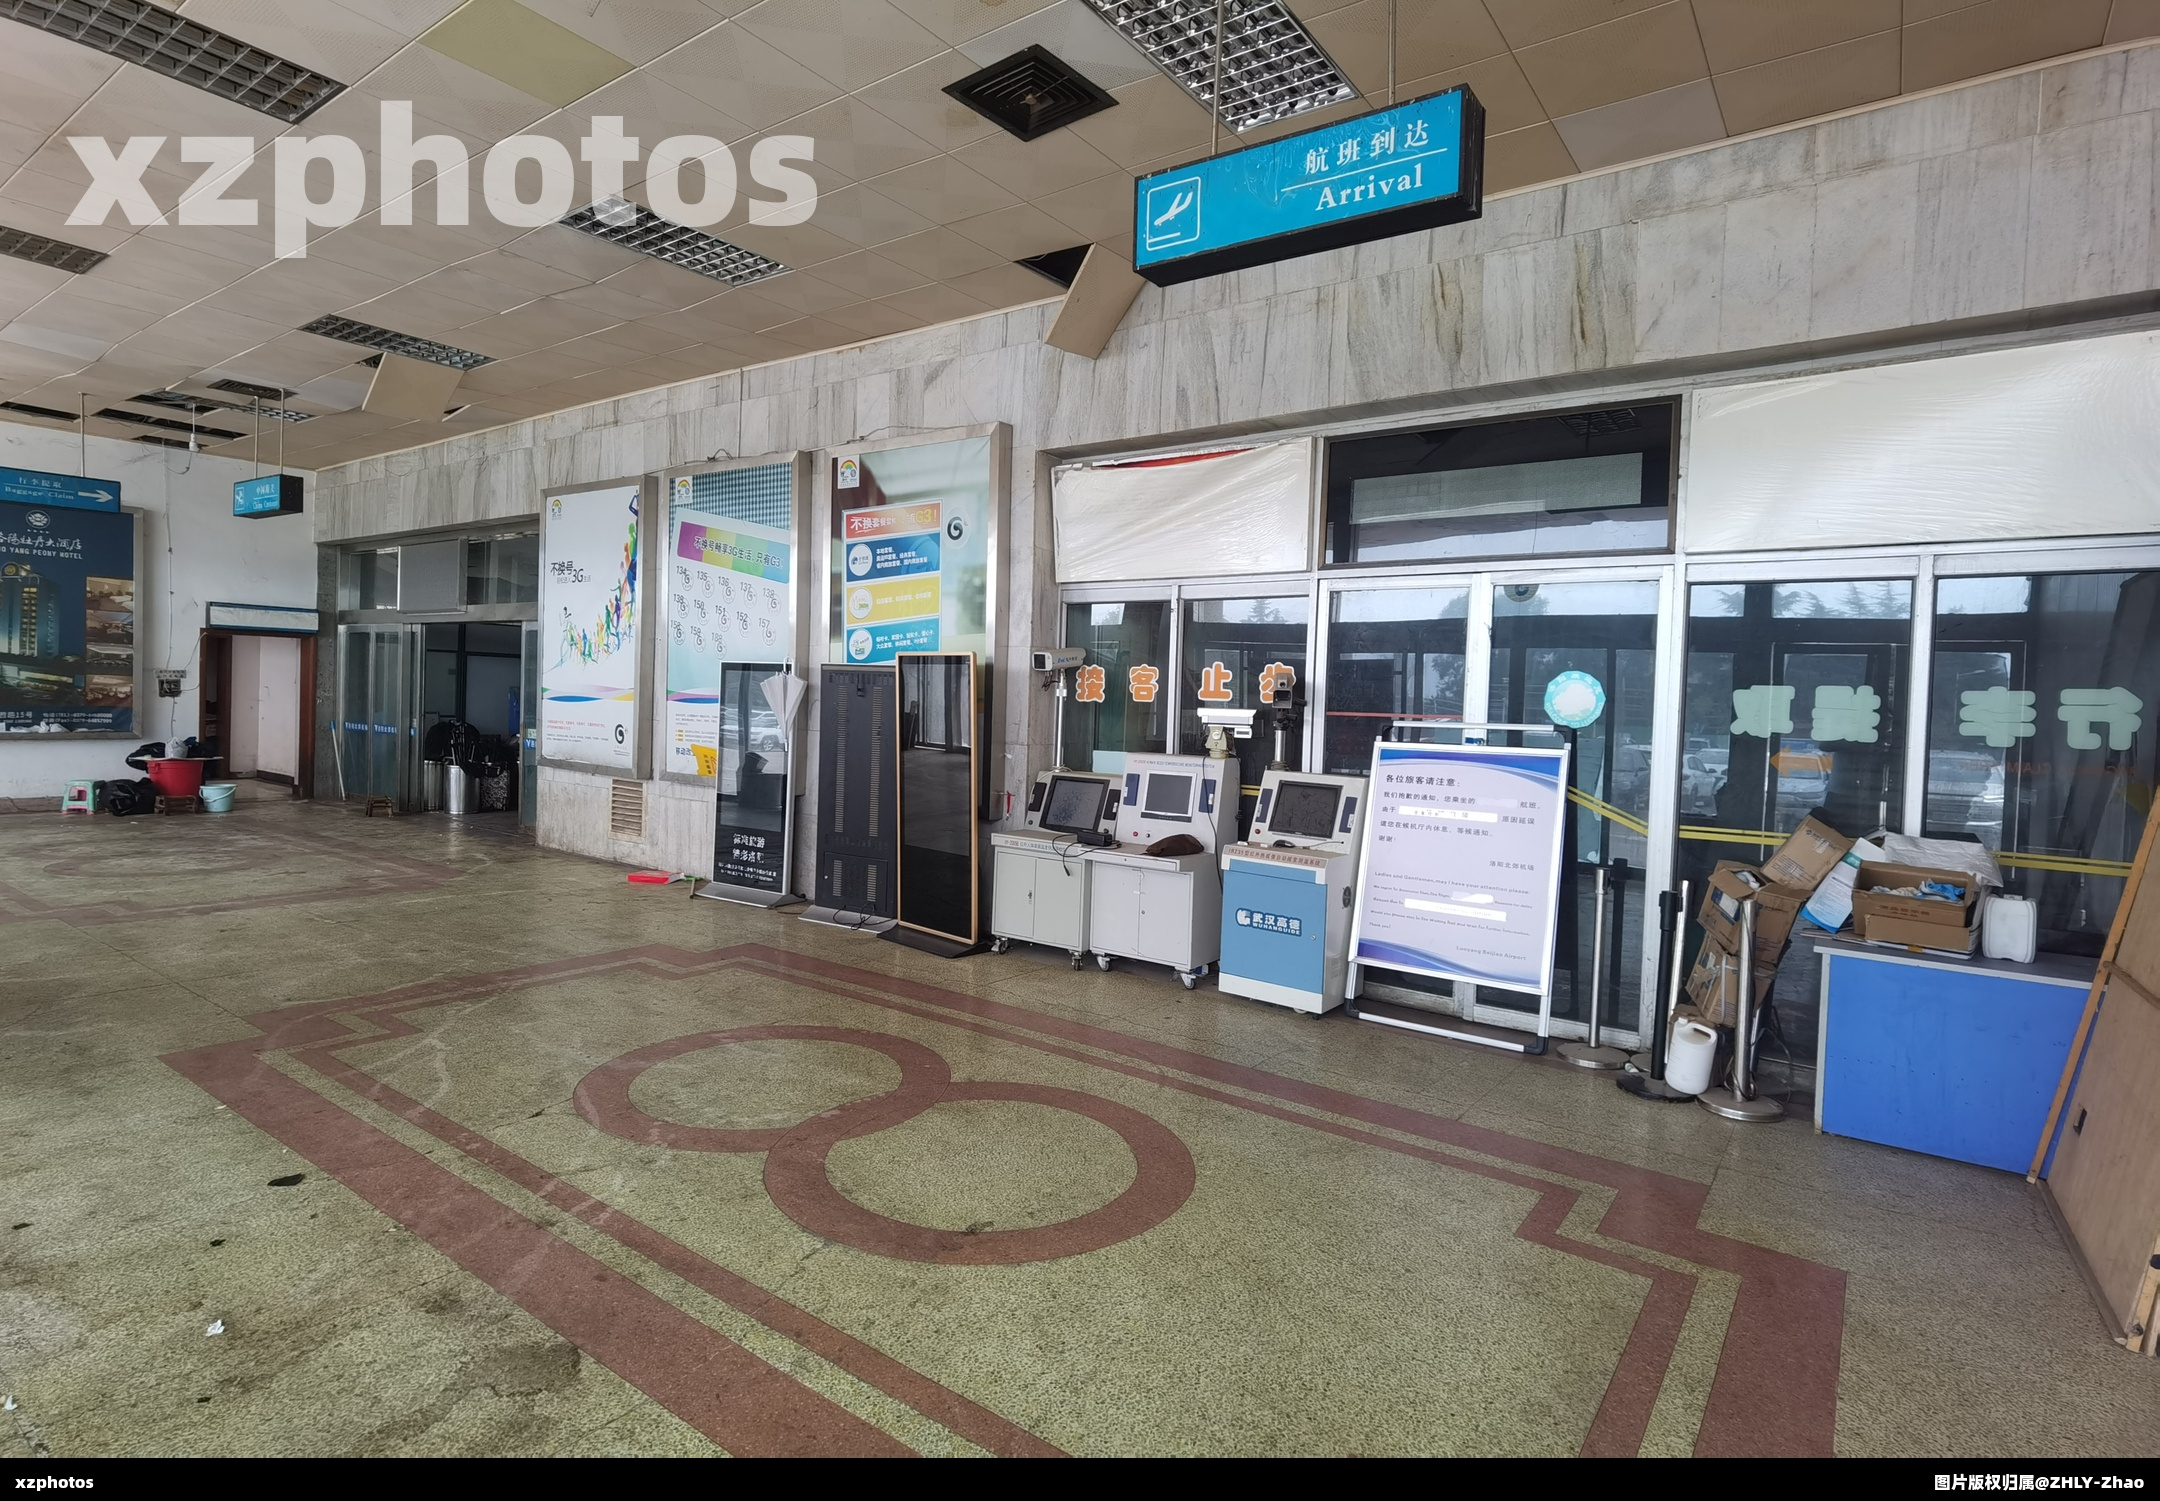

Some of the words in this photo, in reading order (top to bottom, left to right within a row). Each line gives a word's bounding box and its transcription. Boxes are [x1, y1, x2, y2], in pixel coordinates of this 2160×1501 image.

[1304, 119, 1429, 175] 航班到达
[1315, 162, 1423, 212] Arrival
[5, 486, 43, 496] Baggage
[48, 491, 75, 500] Claim
[10, 547, 30, 555] YANG
[32, 549, 57, 557] PEONY
[550, 560, 574, 576] 不换号
[676, 566, 687, 575] 134
[697, 571, 708, 581] 135
[740, 582, 751, 592] 137
[715, 605, 726, 616] 151
[736, 611, 748, 621] 152
[758, 618, 770, 628] 157
[1386, 774, 1460, 787] 各位旅客请注意：
[1502, 815, 1535, 825] 原因延误
[1489, 860, 1535, 872] 洛阳北郊机场
[1480, 883, 1507, 892] attention
[1252, 912, 1300, 930] 武汉高德
[1252, 923, 1301, 935] WUHANGUIDE
[1456, 945, 1481, 954] Luoyang
[1482, 949, 1502, 957] Beijiao
[1504, 952, 1525, 961] Airport
